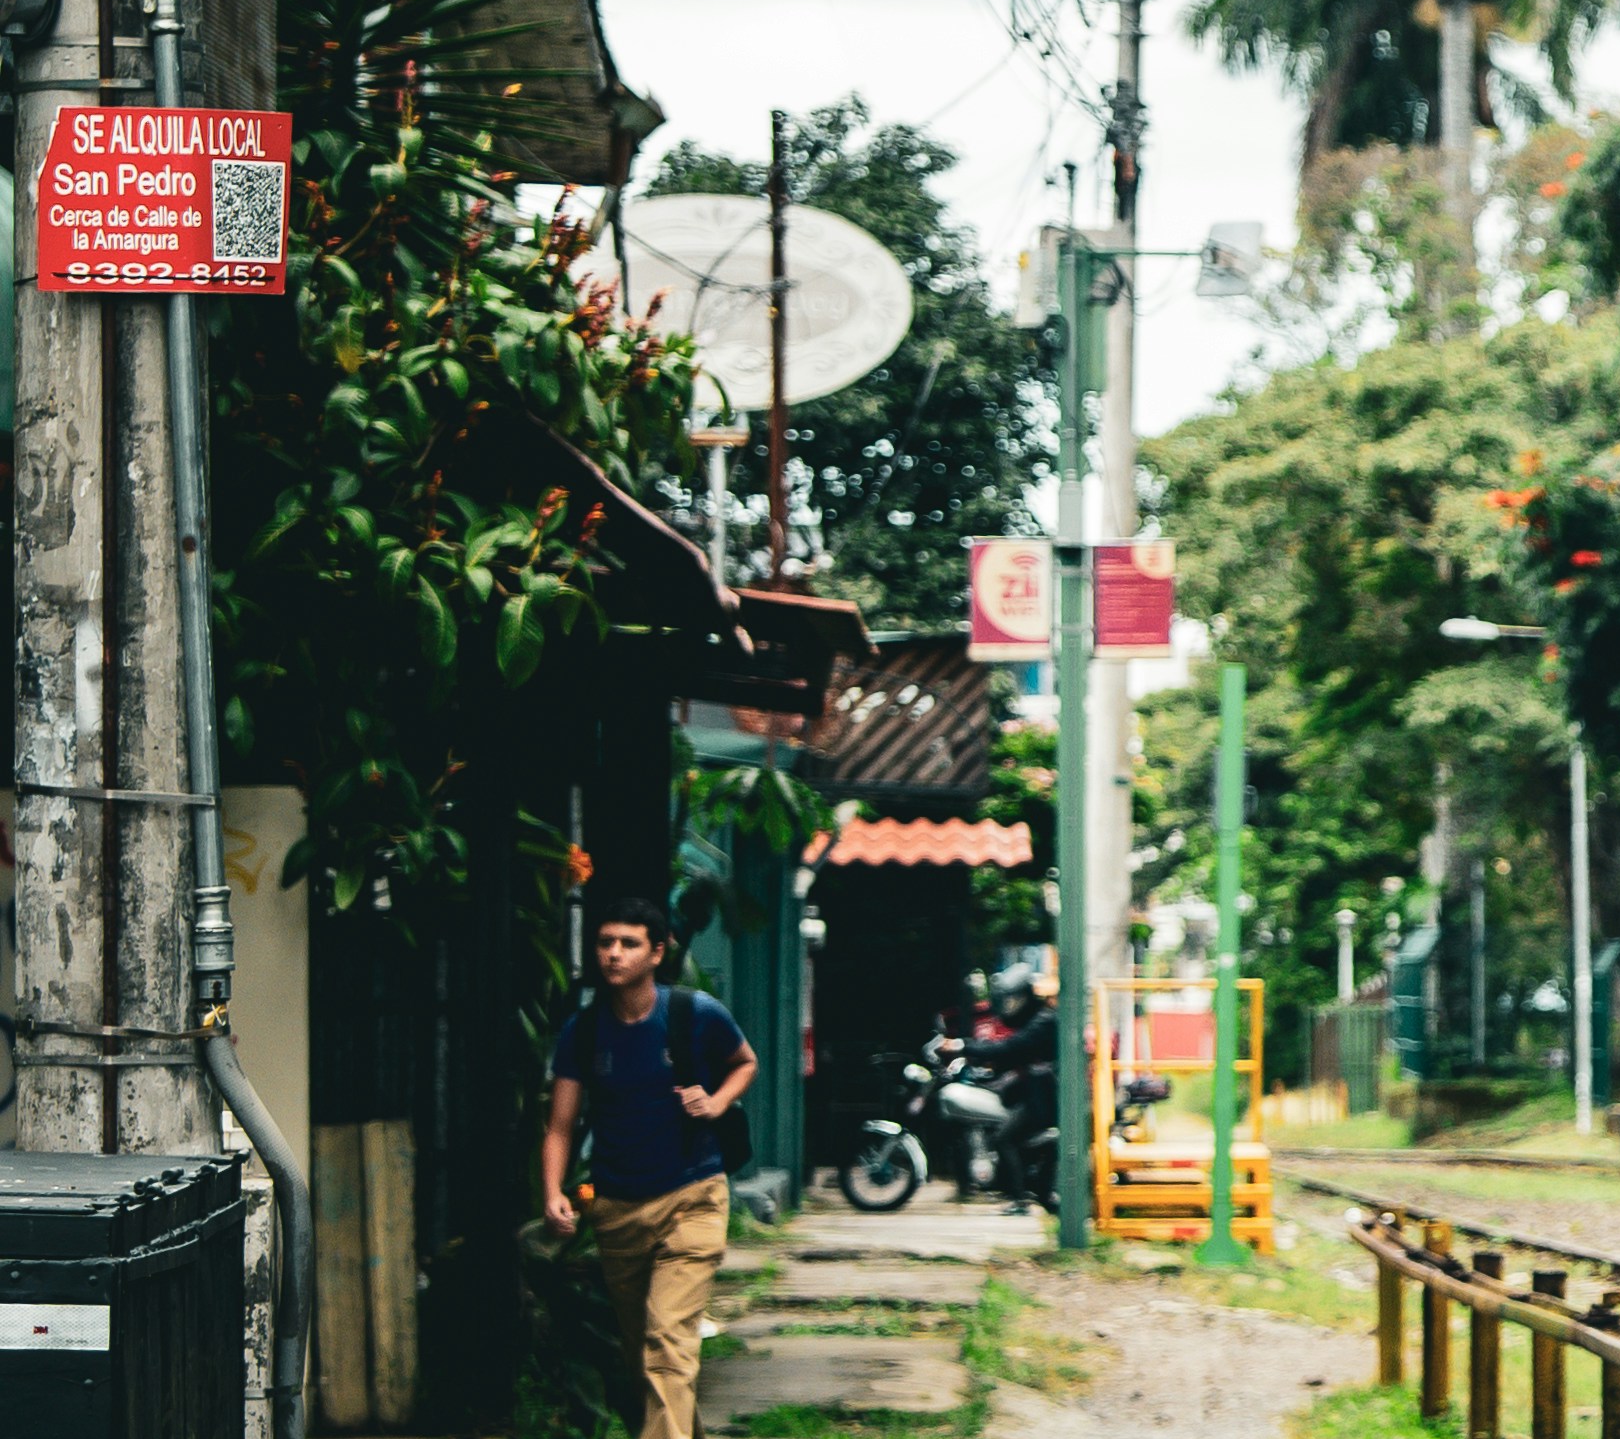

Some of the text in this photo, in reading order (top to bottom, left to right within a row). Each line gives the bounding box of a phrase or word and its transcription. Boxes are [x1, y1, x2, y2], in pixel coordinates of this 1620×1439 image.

[73, 114, 265, 157] SE ALQUILA LOCAL
[54, 163, 196, 196] San Pedro
[50, 205, 202, 227] Cerca de Calle de
[73, 229, 179, 255] la Amargura
[66, 262, 266, 286] 8392-8452
